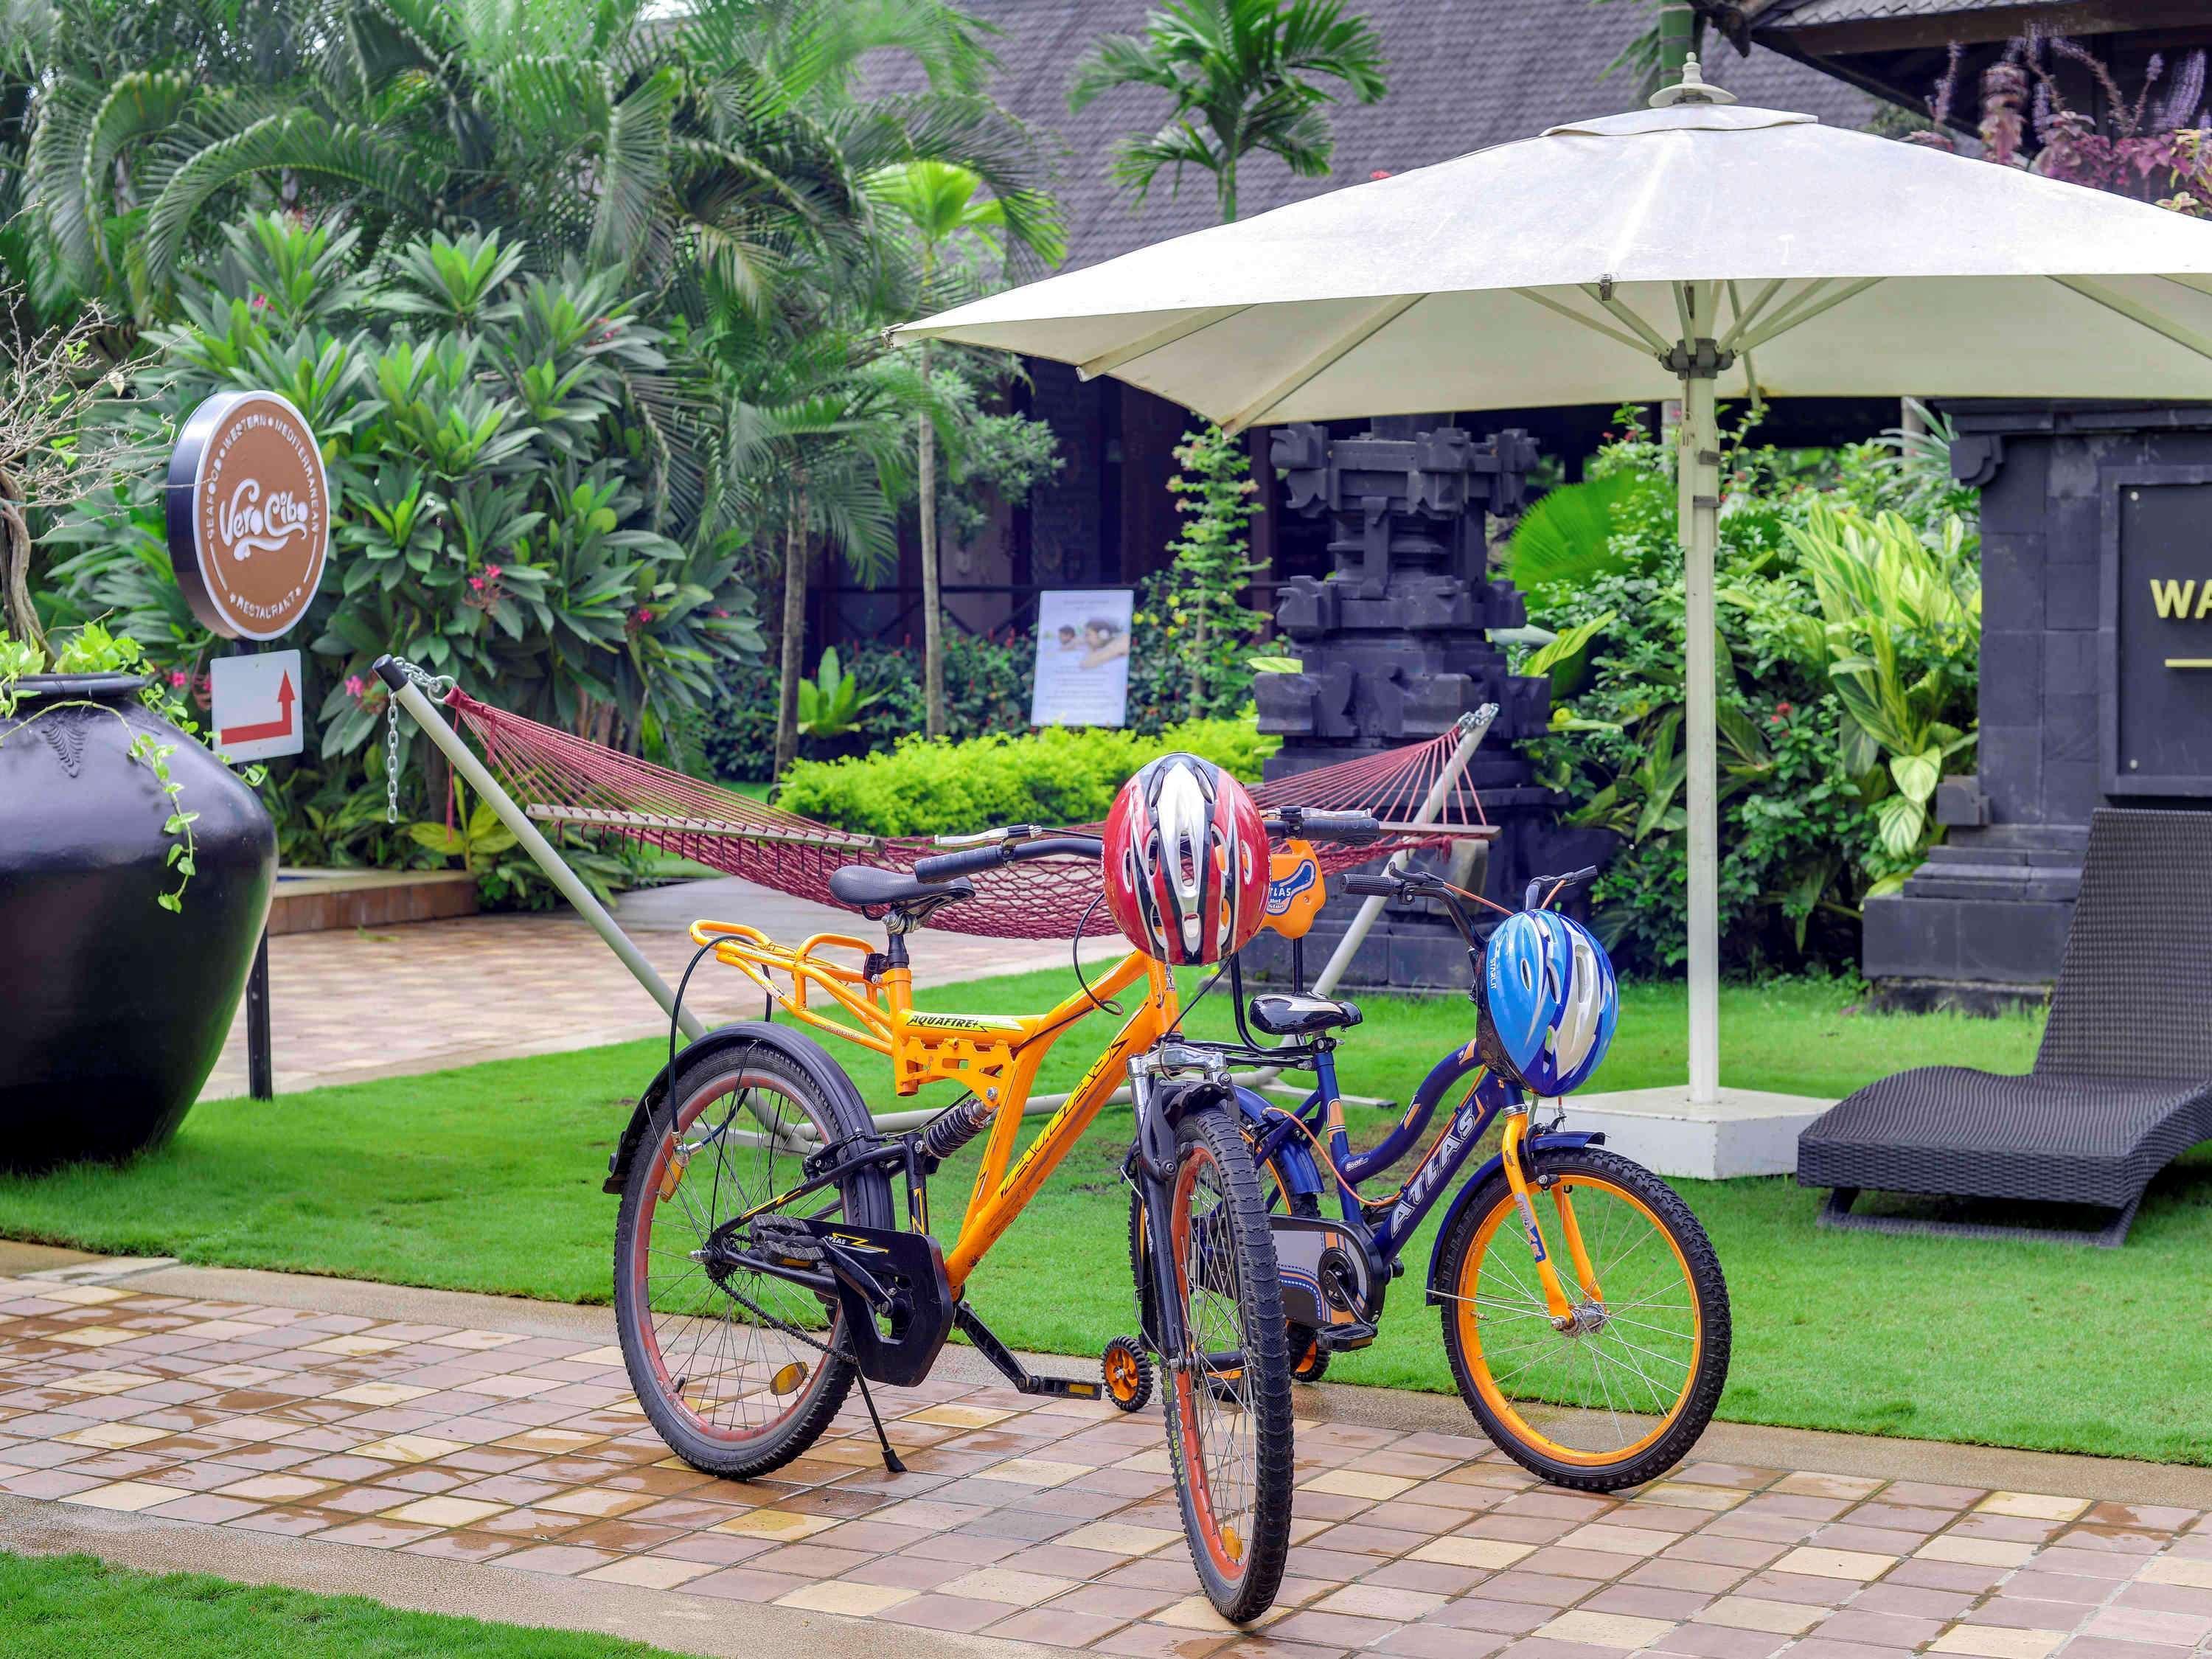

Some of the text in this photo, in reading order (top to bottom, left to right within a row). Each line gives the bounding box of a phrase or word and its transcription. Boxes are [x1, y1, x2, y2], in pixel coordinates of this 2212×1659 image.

[206, 414, 319, 540] SEAFOOD WESTERN MEDITERRANEAN
[219, 479, 309, 546] Vero Cibo
[236, 591, 295, 619] RESTAURANT
[1270, 888, 1291, 897] TLAS
[1391, 1102, 1475, 1239] ATLAS
